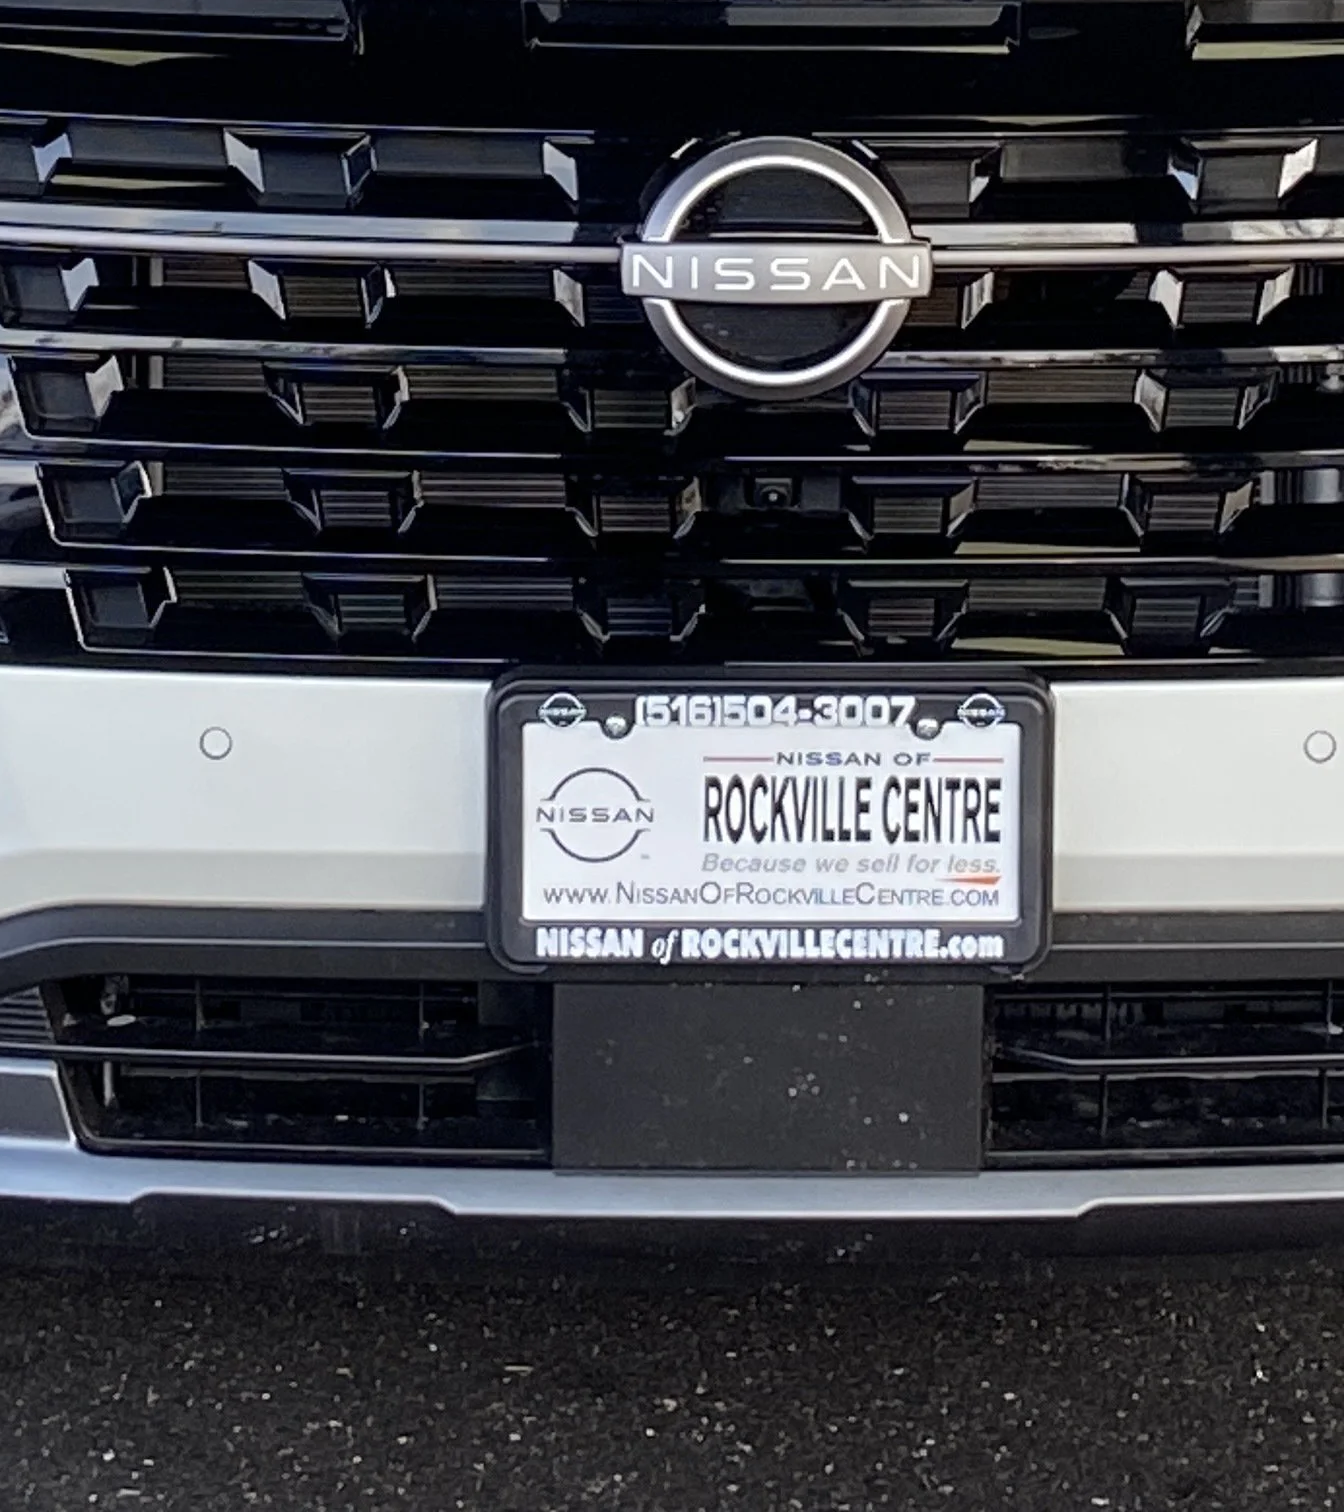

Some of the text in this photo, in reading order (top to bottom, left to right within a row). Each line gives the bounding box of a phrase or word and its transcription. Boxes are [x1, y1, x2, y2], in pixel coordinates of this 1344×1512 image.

[631, 253, 921, 291] NISSAN
[635, 695, 916, 727] (516)504-3007
[776, 752, 931, 766] NISSAN OF
[536, 806, 654, 823] NISSAN
[703, 774, 1002, 844] ROCKVILLE CENTRE
[702, 853, 1001, 874] Because we sell for less.
[536, 928, 1005, 965] NISSAN of ROCKVILLECENTRE.com
